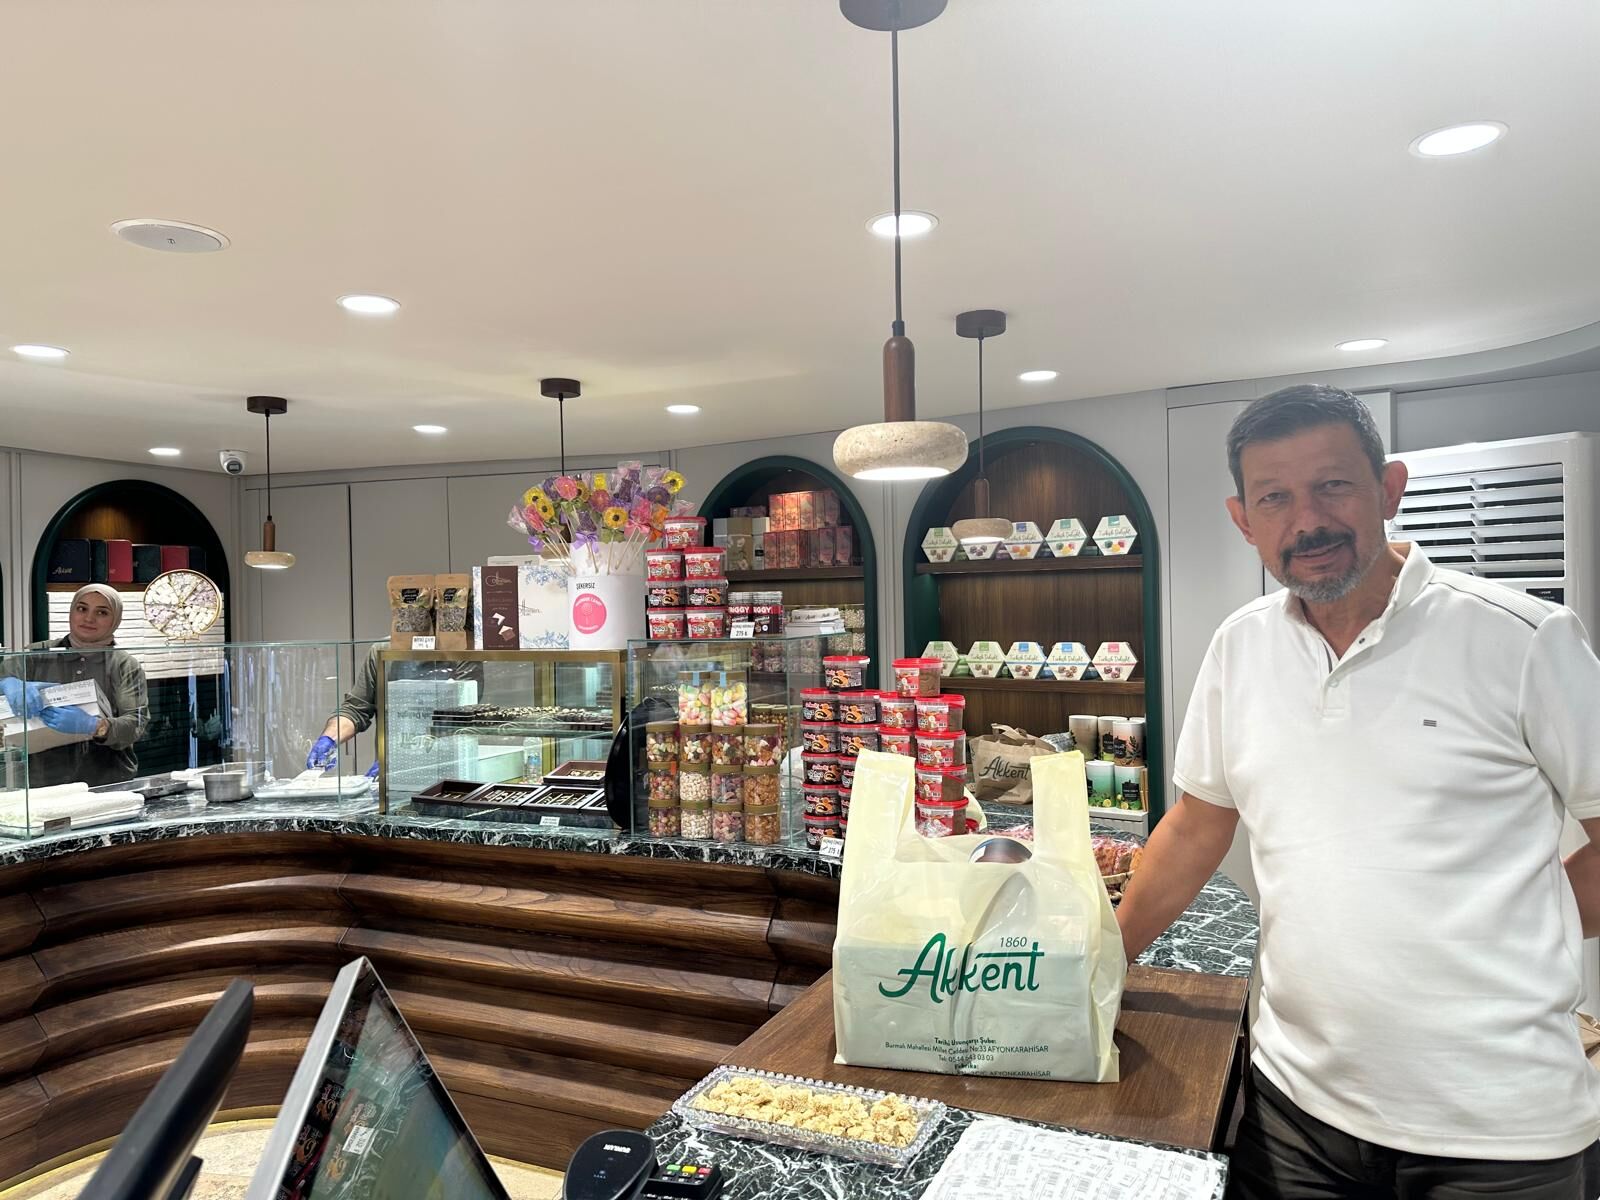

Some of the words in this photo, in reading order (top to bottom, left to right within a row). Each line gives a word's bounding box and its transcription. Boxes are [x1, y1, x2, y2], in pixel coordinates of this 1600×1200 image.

[979, 756, 1031, 780] Akkent
[1000, 936, 1028, 948] 1860
[878, 932, 1044, 1003] Akkent
[906, 1043, 932, 1052] Mahallesi
[988, 1044, 1049, 1054] AFYONKARAHİSAR
